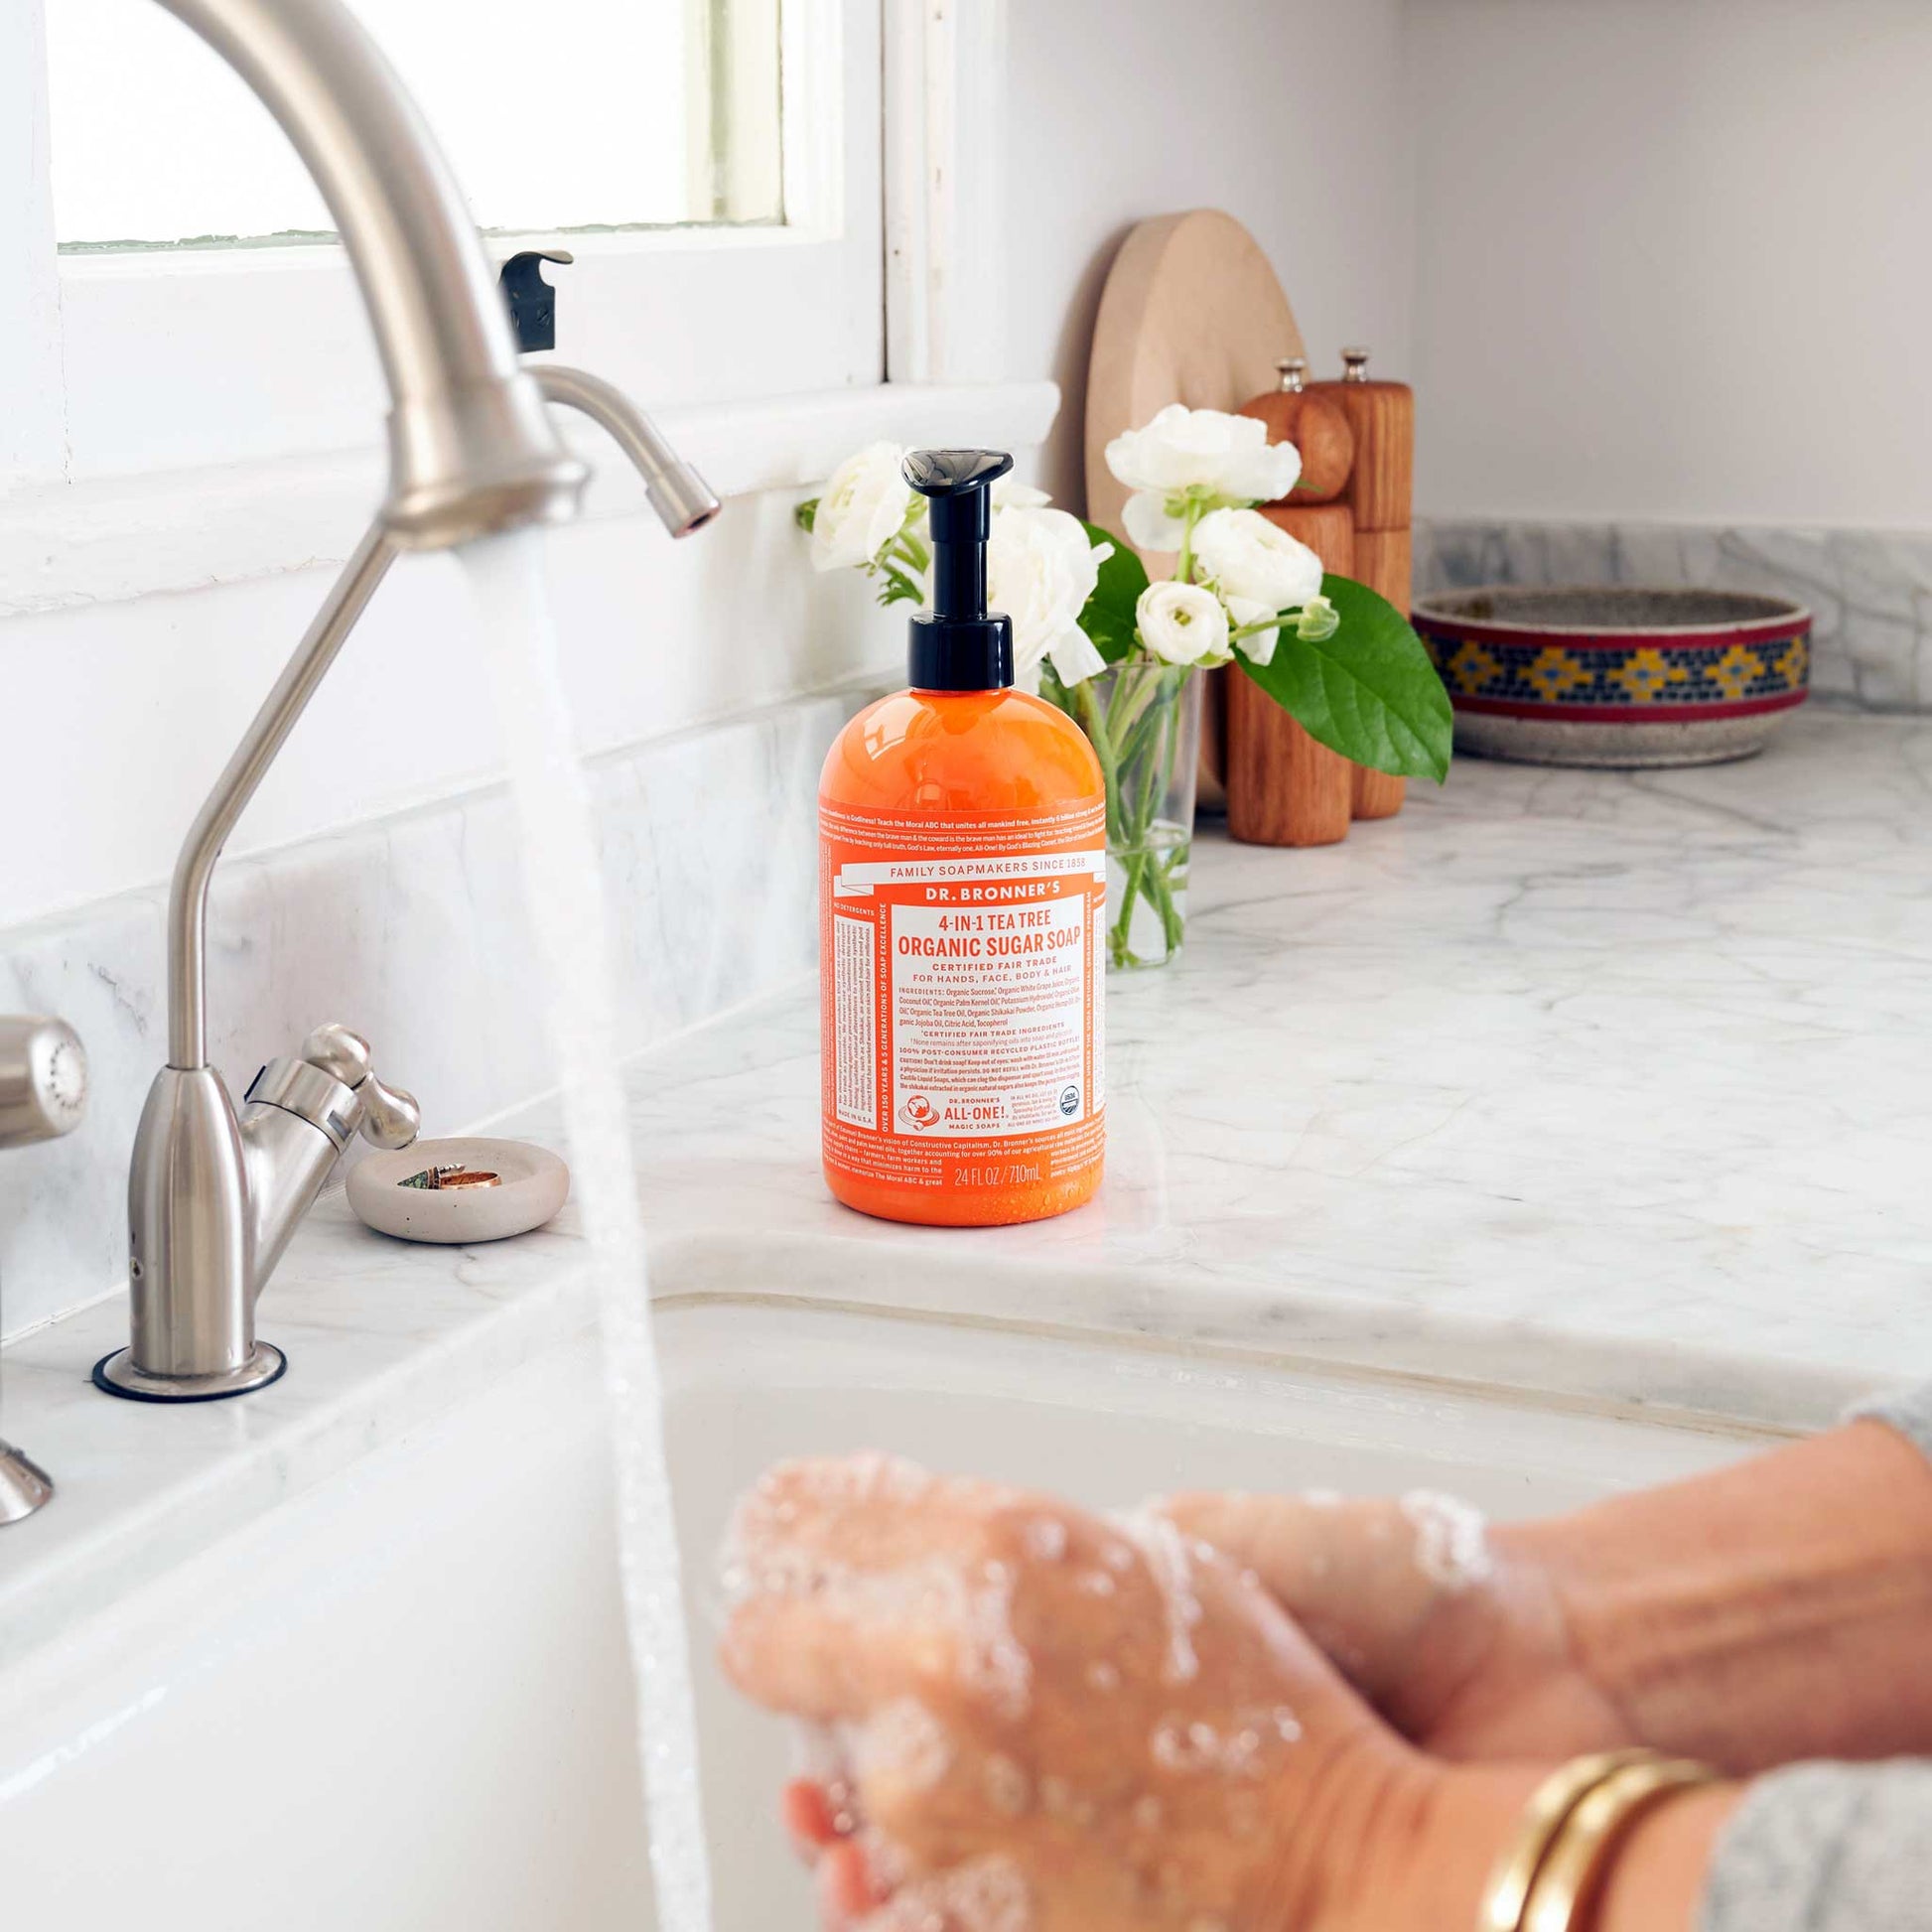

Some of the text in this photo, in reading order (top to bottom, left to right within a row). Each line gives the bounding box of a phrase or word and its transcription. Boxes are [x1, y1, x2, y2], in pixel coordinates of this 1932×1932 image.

[891, 867, 934, 877] FAMILY
[939, 862, 1028, 875] SOAPMAKERS
[1032, 859, 1064, 870] SINCE
[961, 880, 1060, 901] BRONNER'S
[939, 910, 1051, 931] 4-IN-1 TEA TREE
[899, 926, 1080, 957] ORGANIC SUGAR SOAP
[998, 961, 1022, 970] FAIR
[1026, 956, 1057, 967] TRADE
[1016, 970, 1041, 980] BODY
[880, 981, 887, 991] OF
[946, 989, 969, 997] Organic
[997, 986, 1019, 996] Organic
[899, 997, 921, 1005] Coconut
[910, 1008, 932, 1016] Organic
[977, 1019, 1008, 1027] Tocopherol
[1019, 1022, 1064, 1034] INGREDIENTS
[990, 1046, 1028, 1055] RECYCLED
[945, 1106, 1004, 1120] ALL-ONE!
[910, 1140, 952, 1148] Constructive
[898, 1148, 923, 1156] together
[886, 1174, 903, 1183] Moral
[955, 1168, 968, 1186] 24
[971, 1169, 983, 1186] FL
